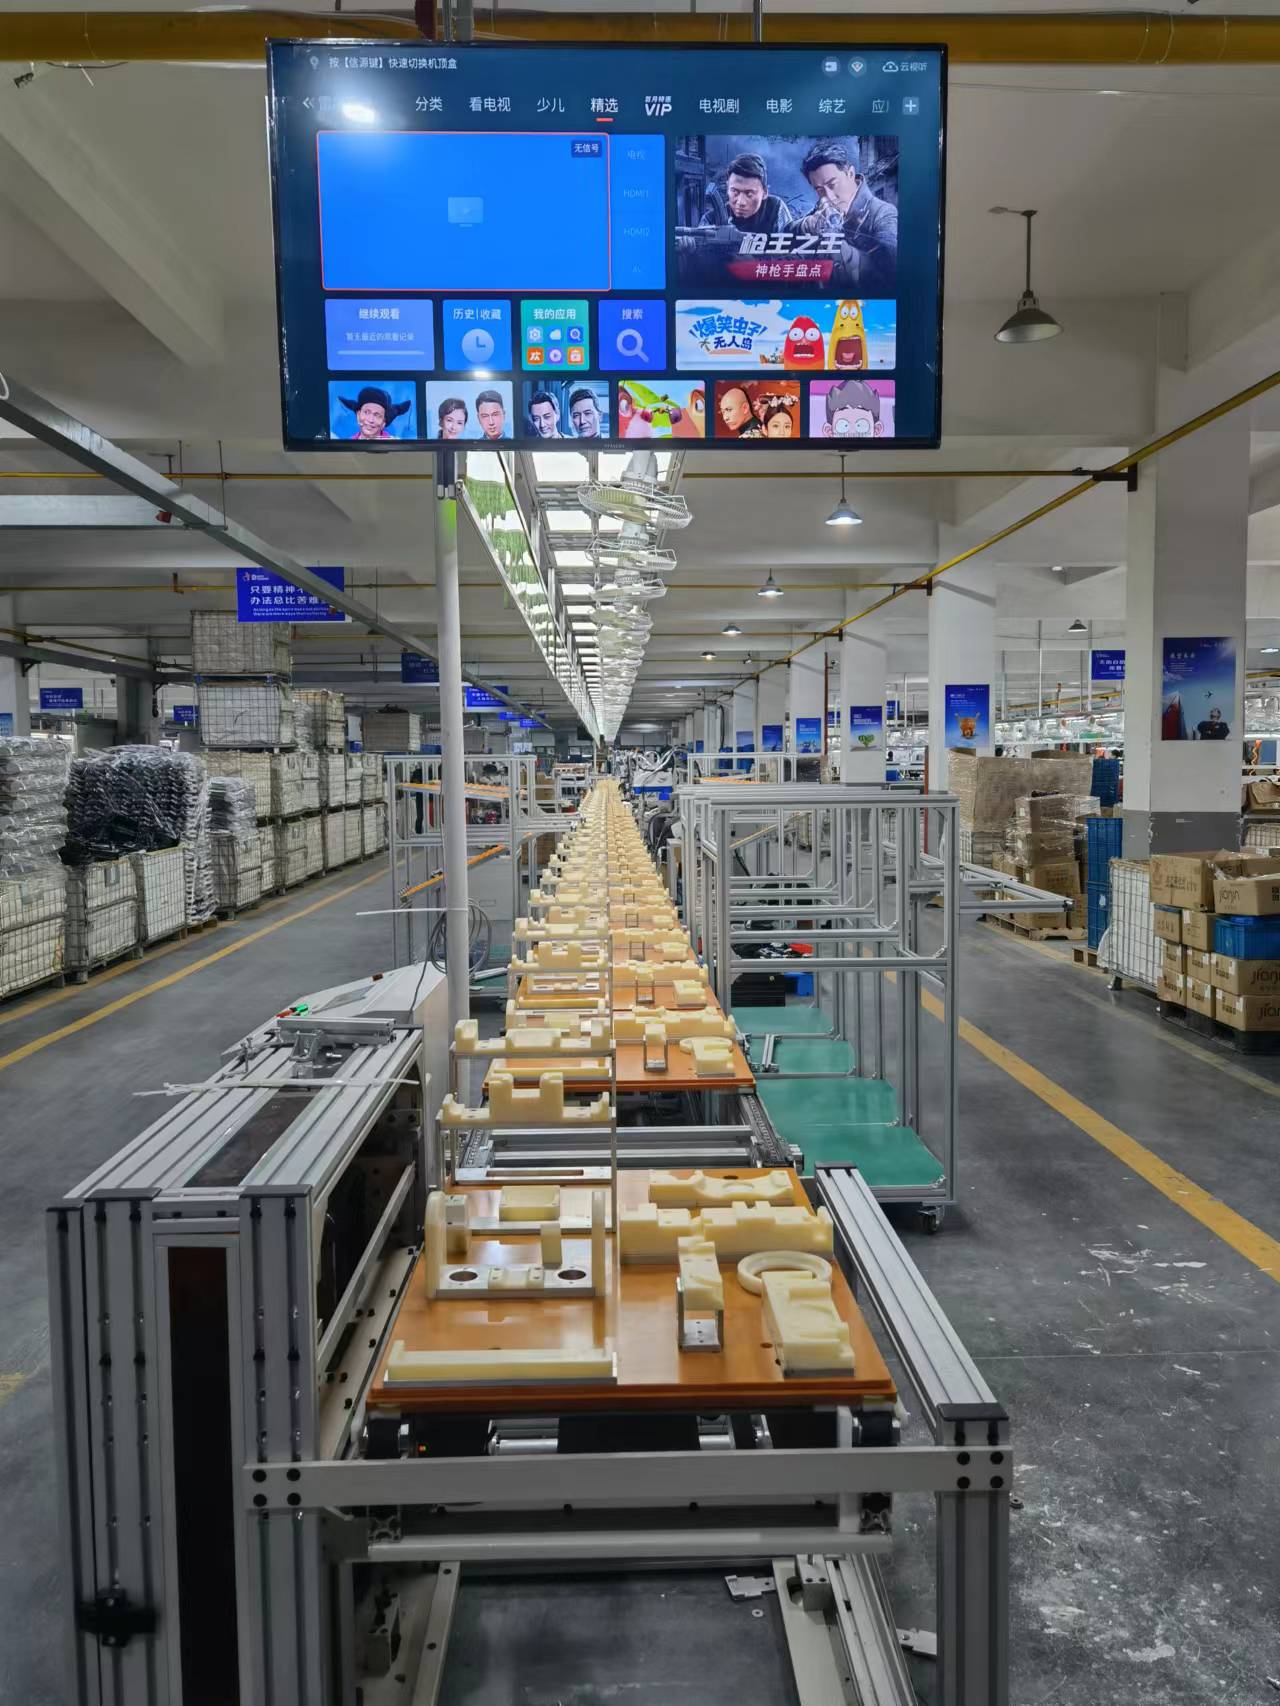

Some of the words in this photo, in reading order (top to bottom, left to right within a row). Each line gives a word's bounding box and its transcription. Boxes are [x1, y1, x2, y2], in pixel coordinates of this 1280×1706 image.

[328, 56, 457, 69] 按【信源键】快速切换机顶盒
[415, 97, 443, 111] 分类
[469, 97, 511, 112] 看电视
[537, 98, 565, 112] 少儿
[591, 98, 619, 113] 精选
[645, 103, 673, 116] VIP
[699, 98, 740, 113] 电视剧
[766, 98, 793, 113] 电影
[818, 98, 846, 113] 综艺
[574, 143, 599, 153] 无信号
[739, 232, 845, 254] 枪王之王
[755, 264, 821, 278] 神枪手盘点
[359, 308, 400, 320] 继续观看
[533, 309, 577, 321] 我的应用
[622, 309, 644, 320] 搜索
[714, 335, 753, 350] 无人岛
